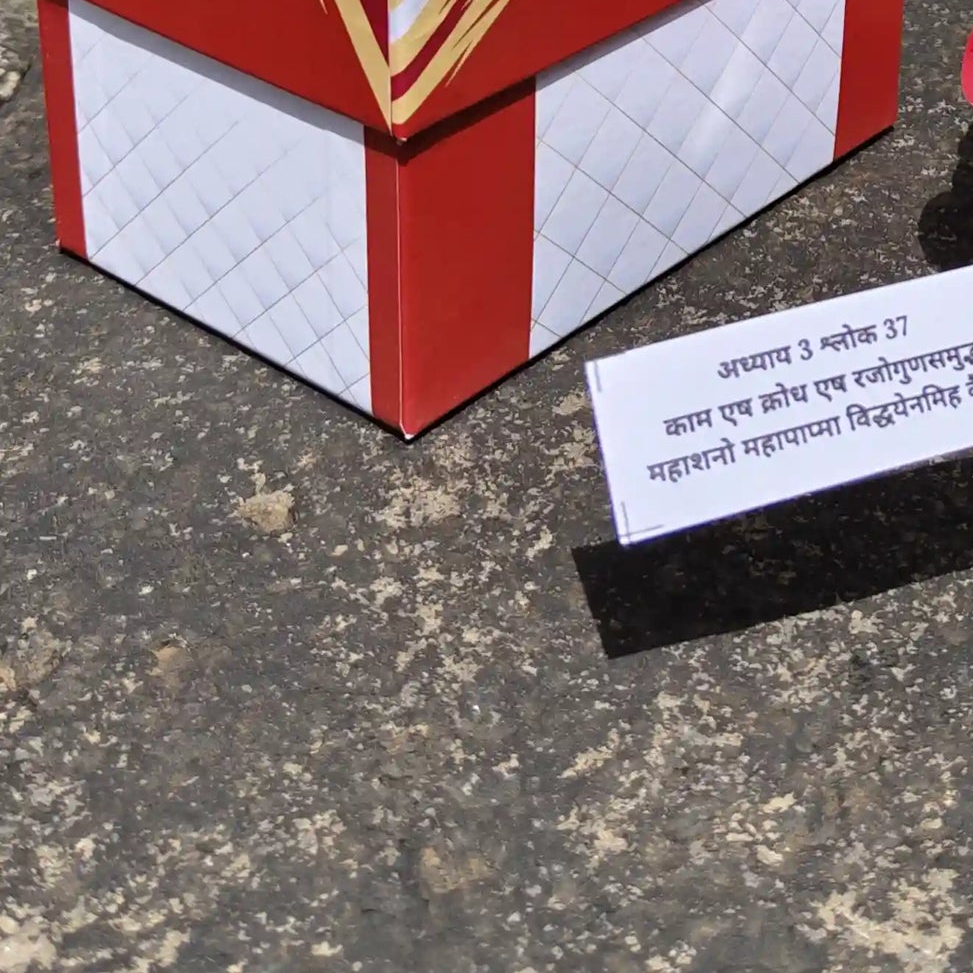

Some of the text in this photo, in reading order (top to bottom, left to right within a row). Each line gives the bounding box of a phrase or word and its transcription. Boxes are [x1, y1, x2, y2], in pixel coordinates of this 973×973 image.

[717, 316, 910, 380] अध्याय 3 श्लोक 37
[663, 407, 713, 437] काम
[718, 395, 753, 427] एष
[759, 380, 808, 415] क्रोध
[814, 369, 847, 402] एष
[647, 437, 737, 484] महाशनो
[741, 414, 842, 458] महापाप्मा
